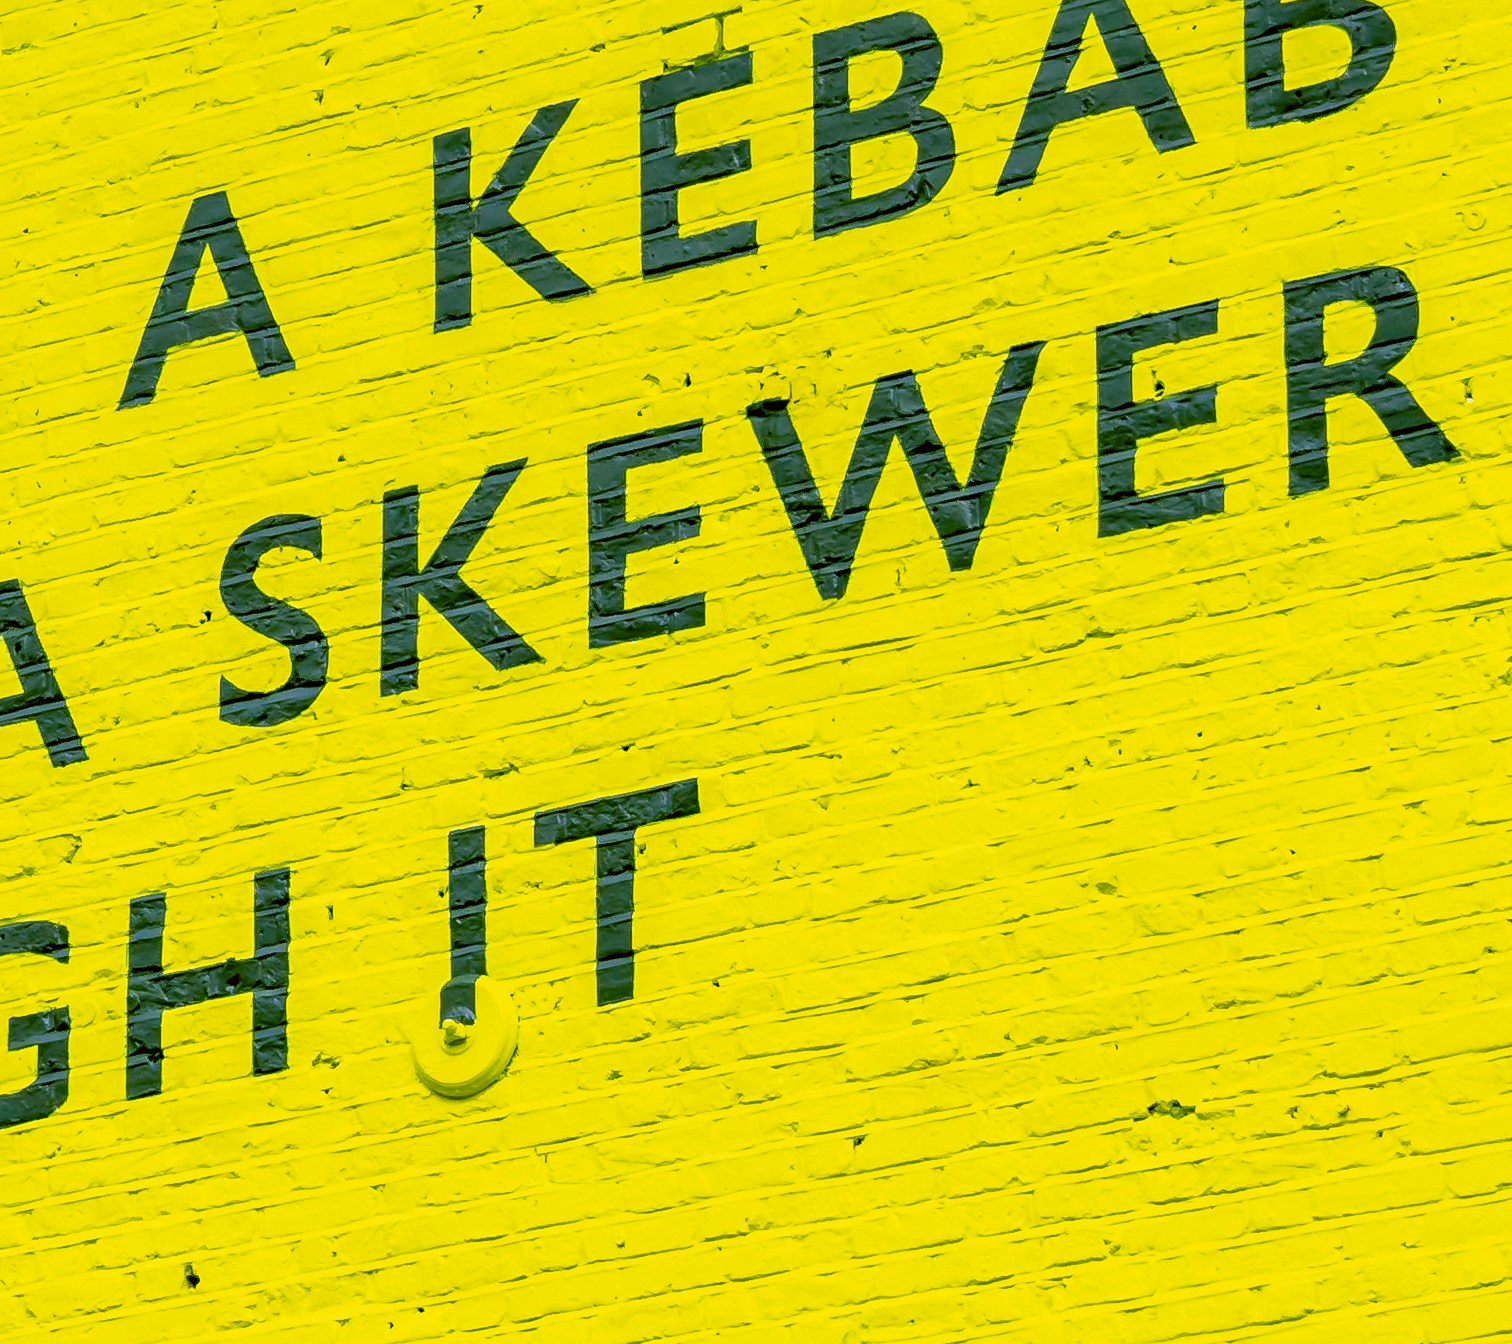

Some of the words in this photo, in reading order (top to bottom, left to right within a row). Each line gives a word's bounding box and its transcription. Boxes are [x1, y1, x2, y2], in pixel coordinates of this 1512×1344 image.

[117, 191, 296, 411] A
[218, 264, 1461, 727] SKEWER
[439, 778, 701, 1029] IT
